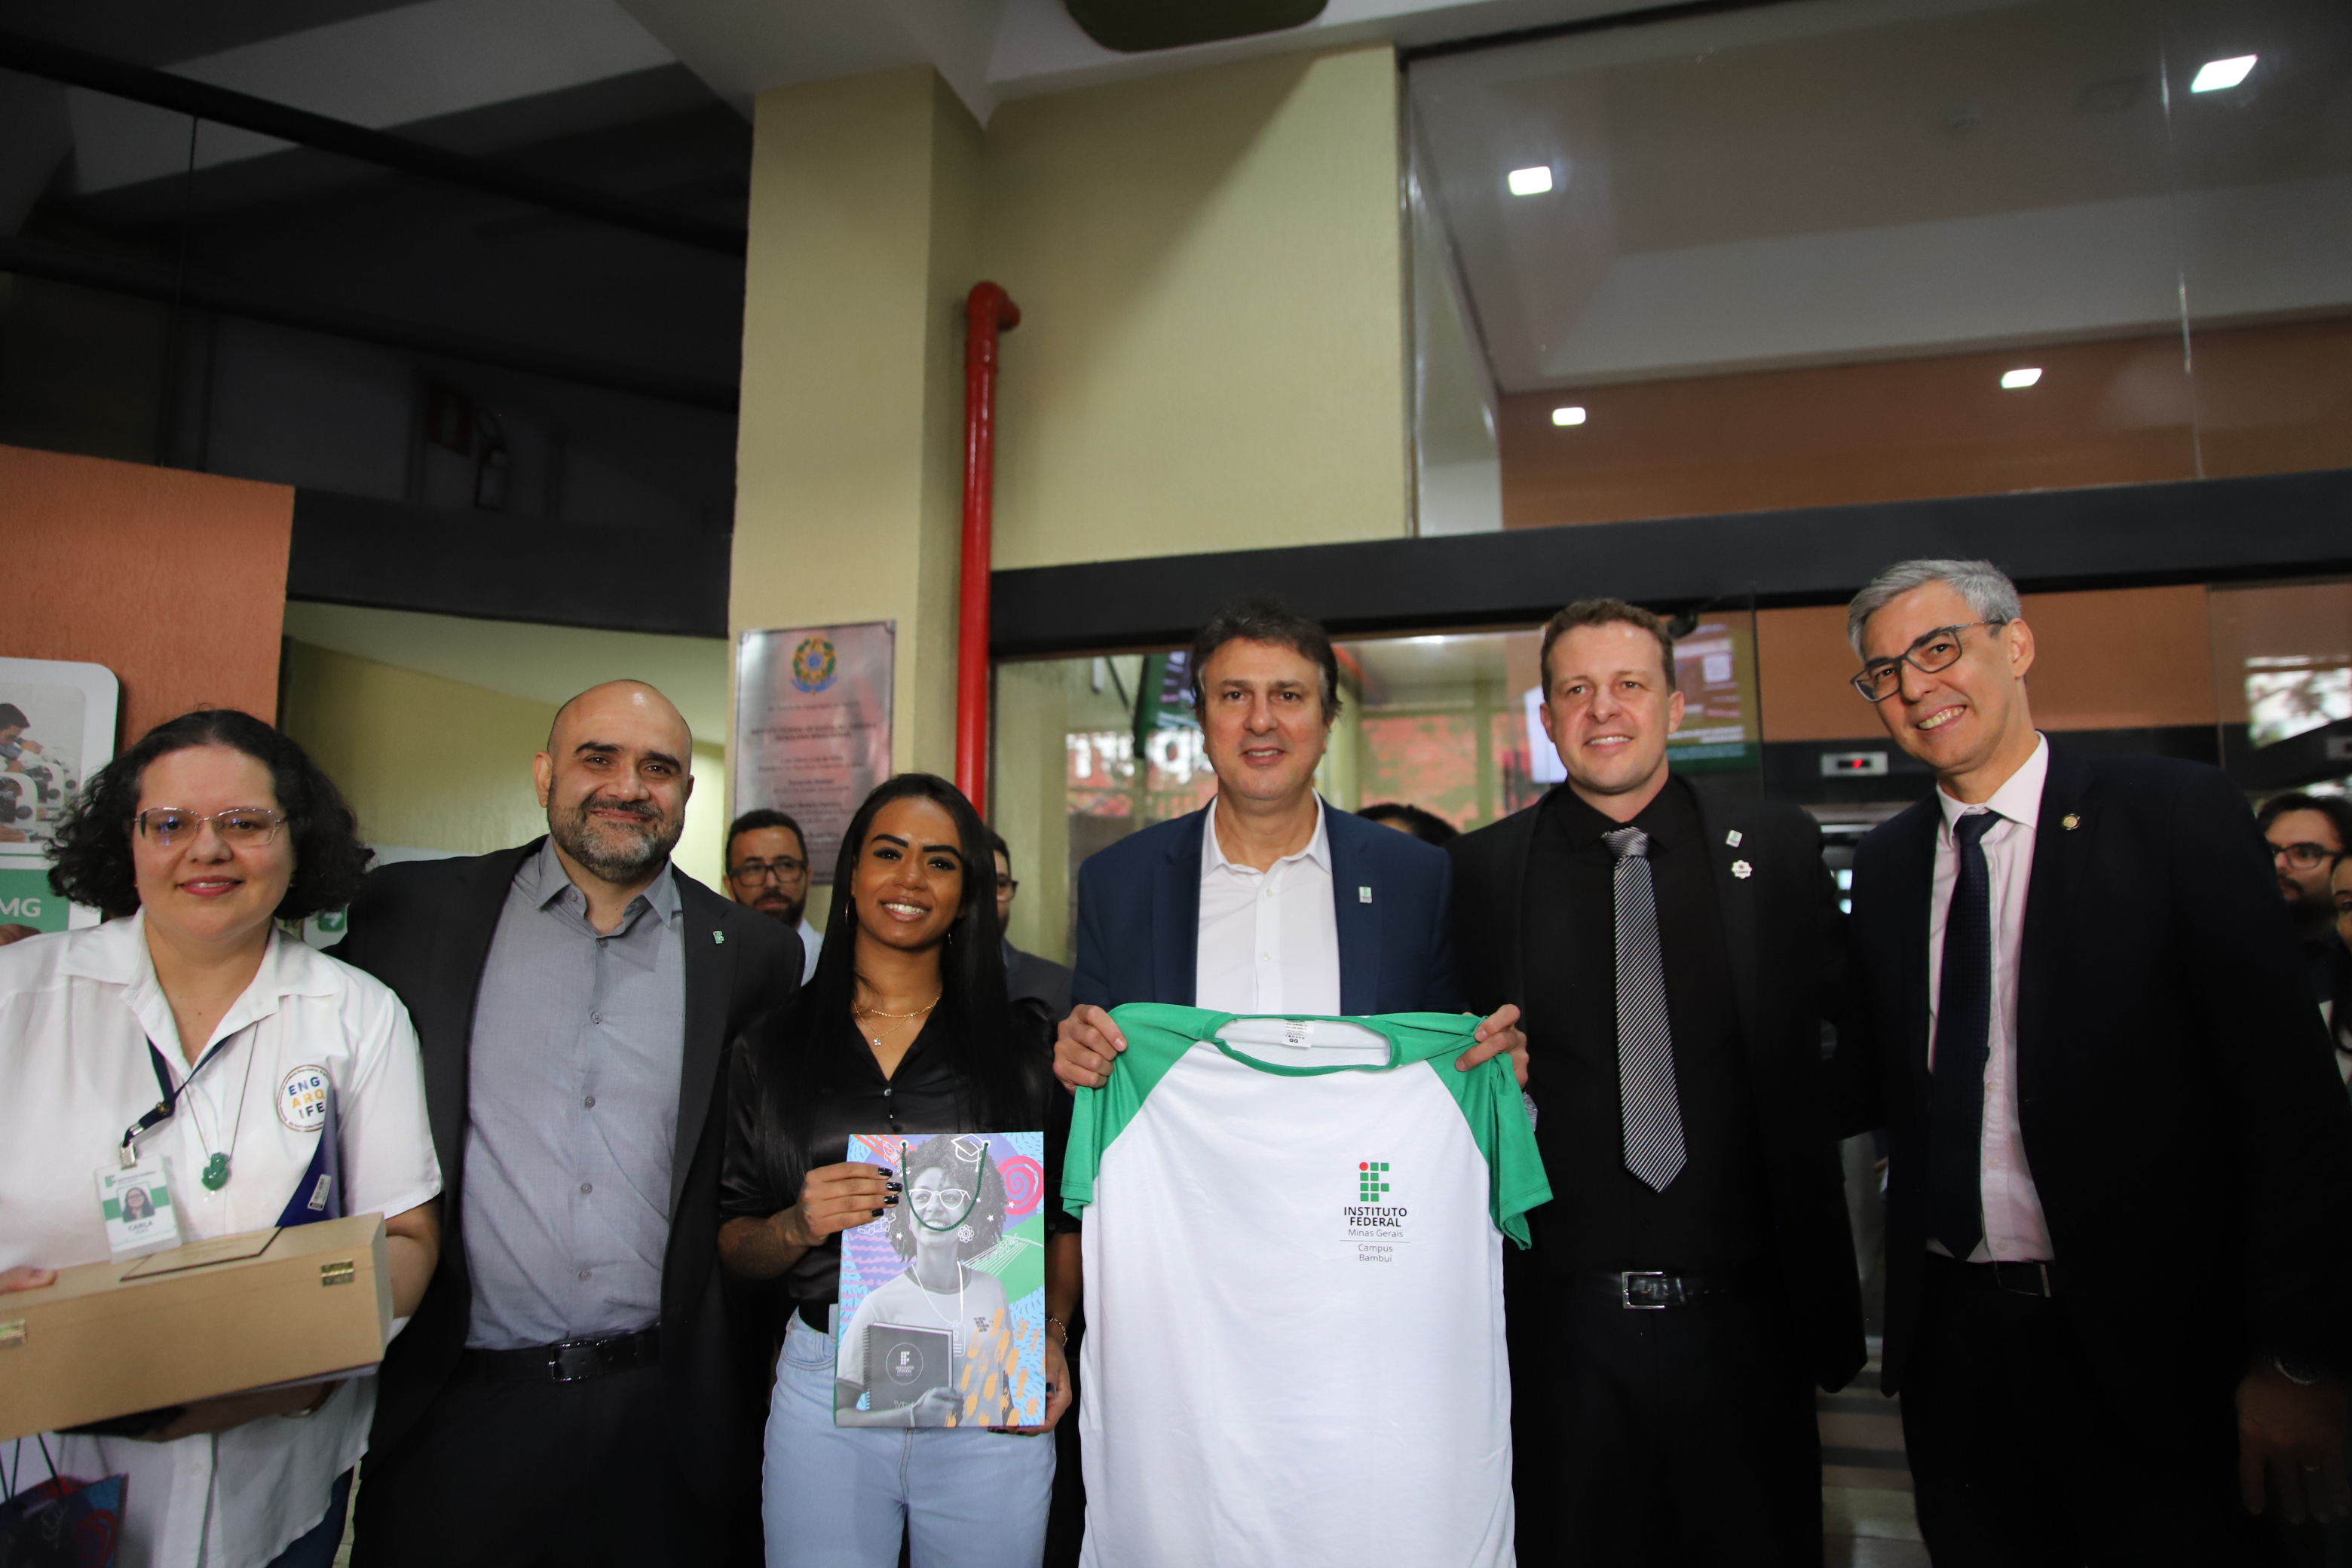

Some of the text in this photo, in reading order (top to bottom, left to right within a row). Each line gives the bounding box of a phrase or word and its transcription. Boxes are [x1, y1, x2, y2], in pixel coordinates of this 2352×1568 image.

[288, 1076, 320, 1096] ENG
[292, 1089, 325, 1109] ARQ
[299, 1101, 325, 1119] IFE
[1344, 1206, 1407, 1217] INSTITUTO
[1350, 1217, 1401, 1227] FEDERAL
[1349, 1229, 1403, 1238] Minas Gerais
[1358, 1244, 1393, 1253] Campus
